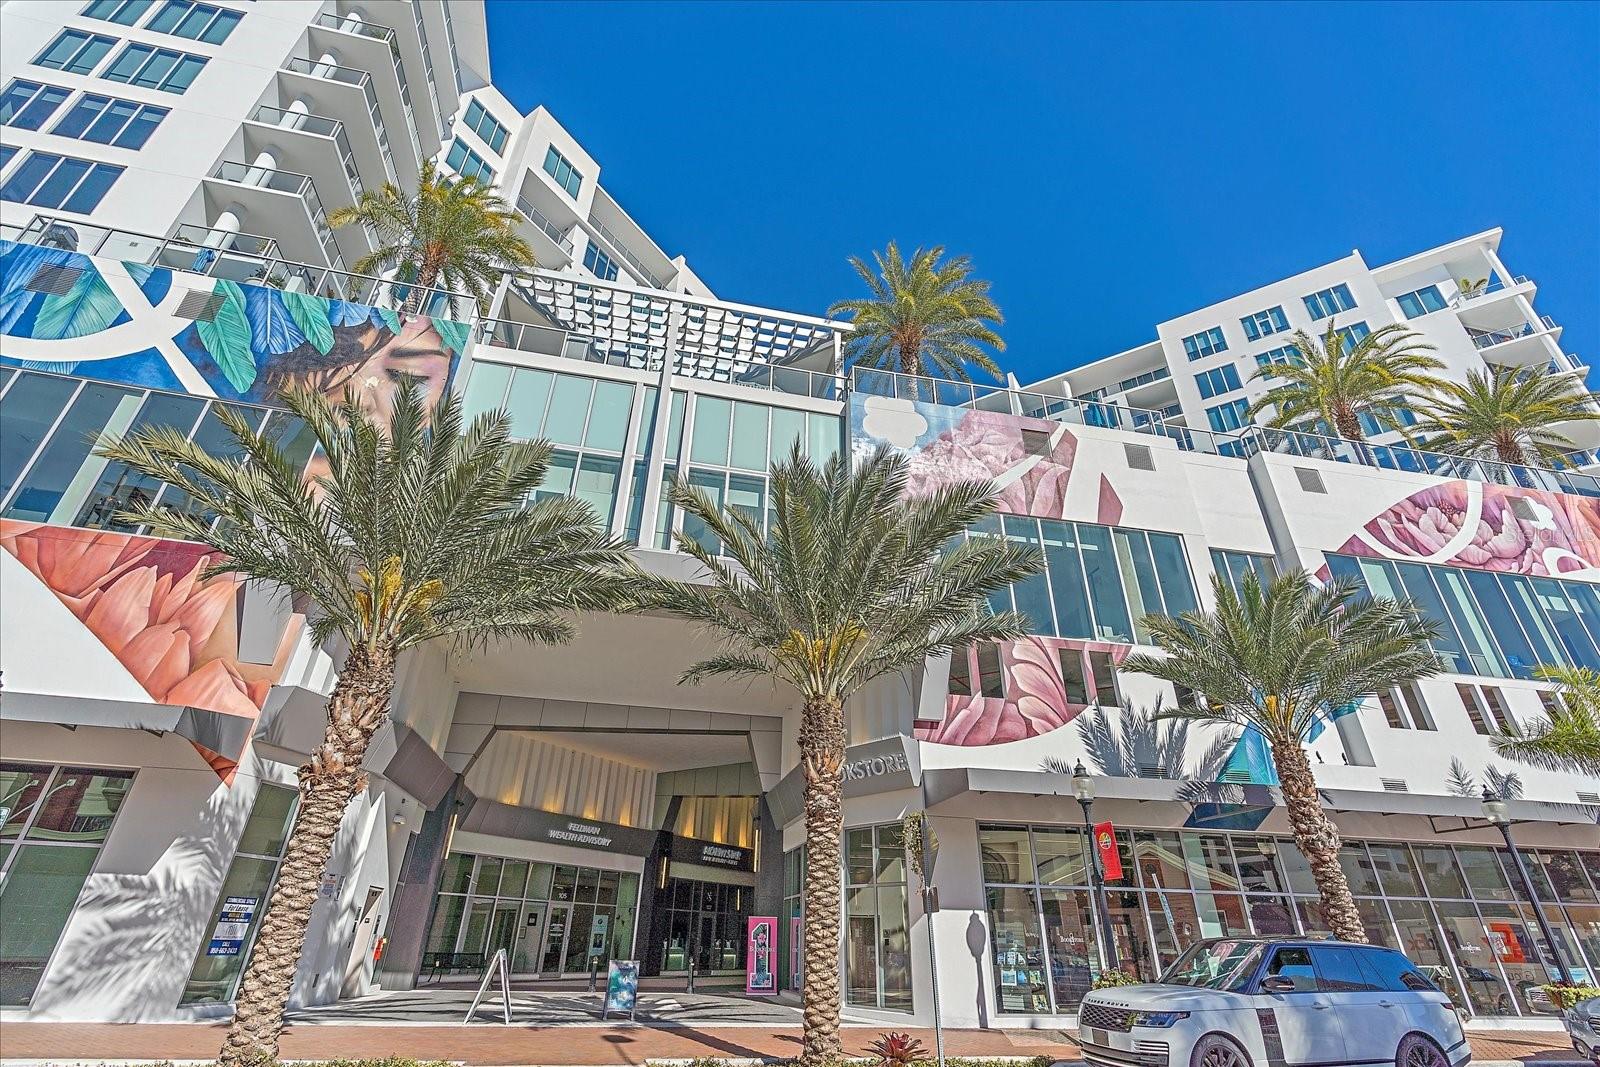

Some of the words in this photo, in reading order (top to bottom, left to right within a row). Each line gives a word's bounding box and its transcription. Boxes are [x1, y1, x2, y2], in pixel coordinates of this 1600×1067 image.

[568, 823, 600, 834] FELDMAN
[549, 830, 578, 841] WEALTH
[577, 834, 612, 846] ADVISORY
